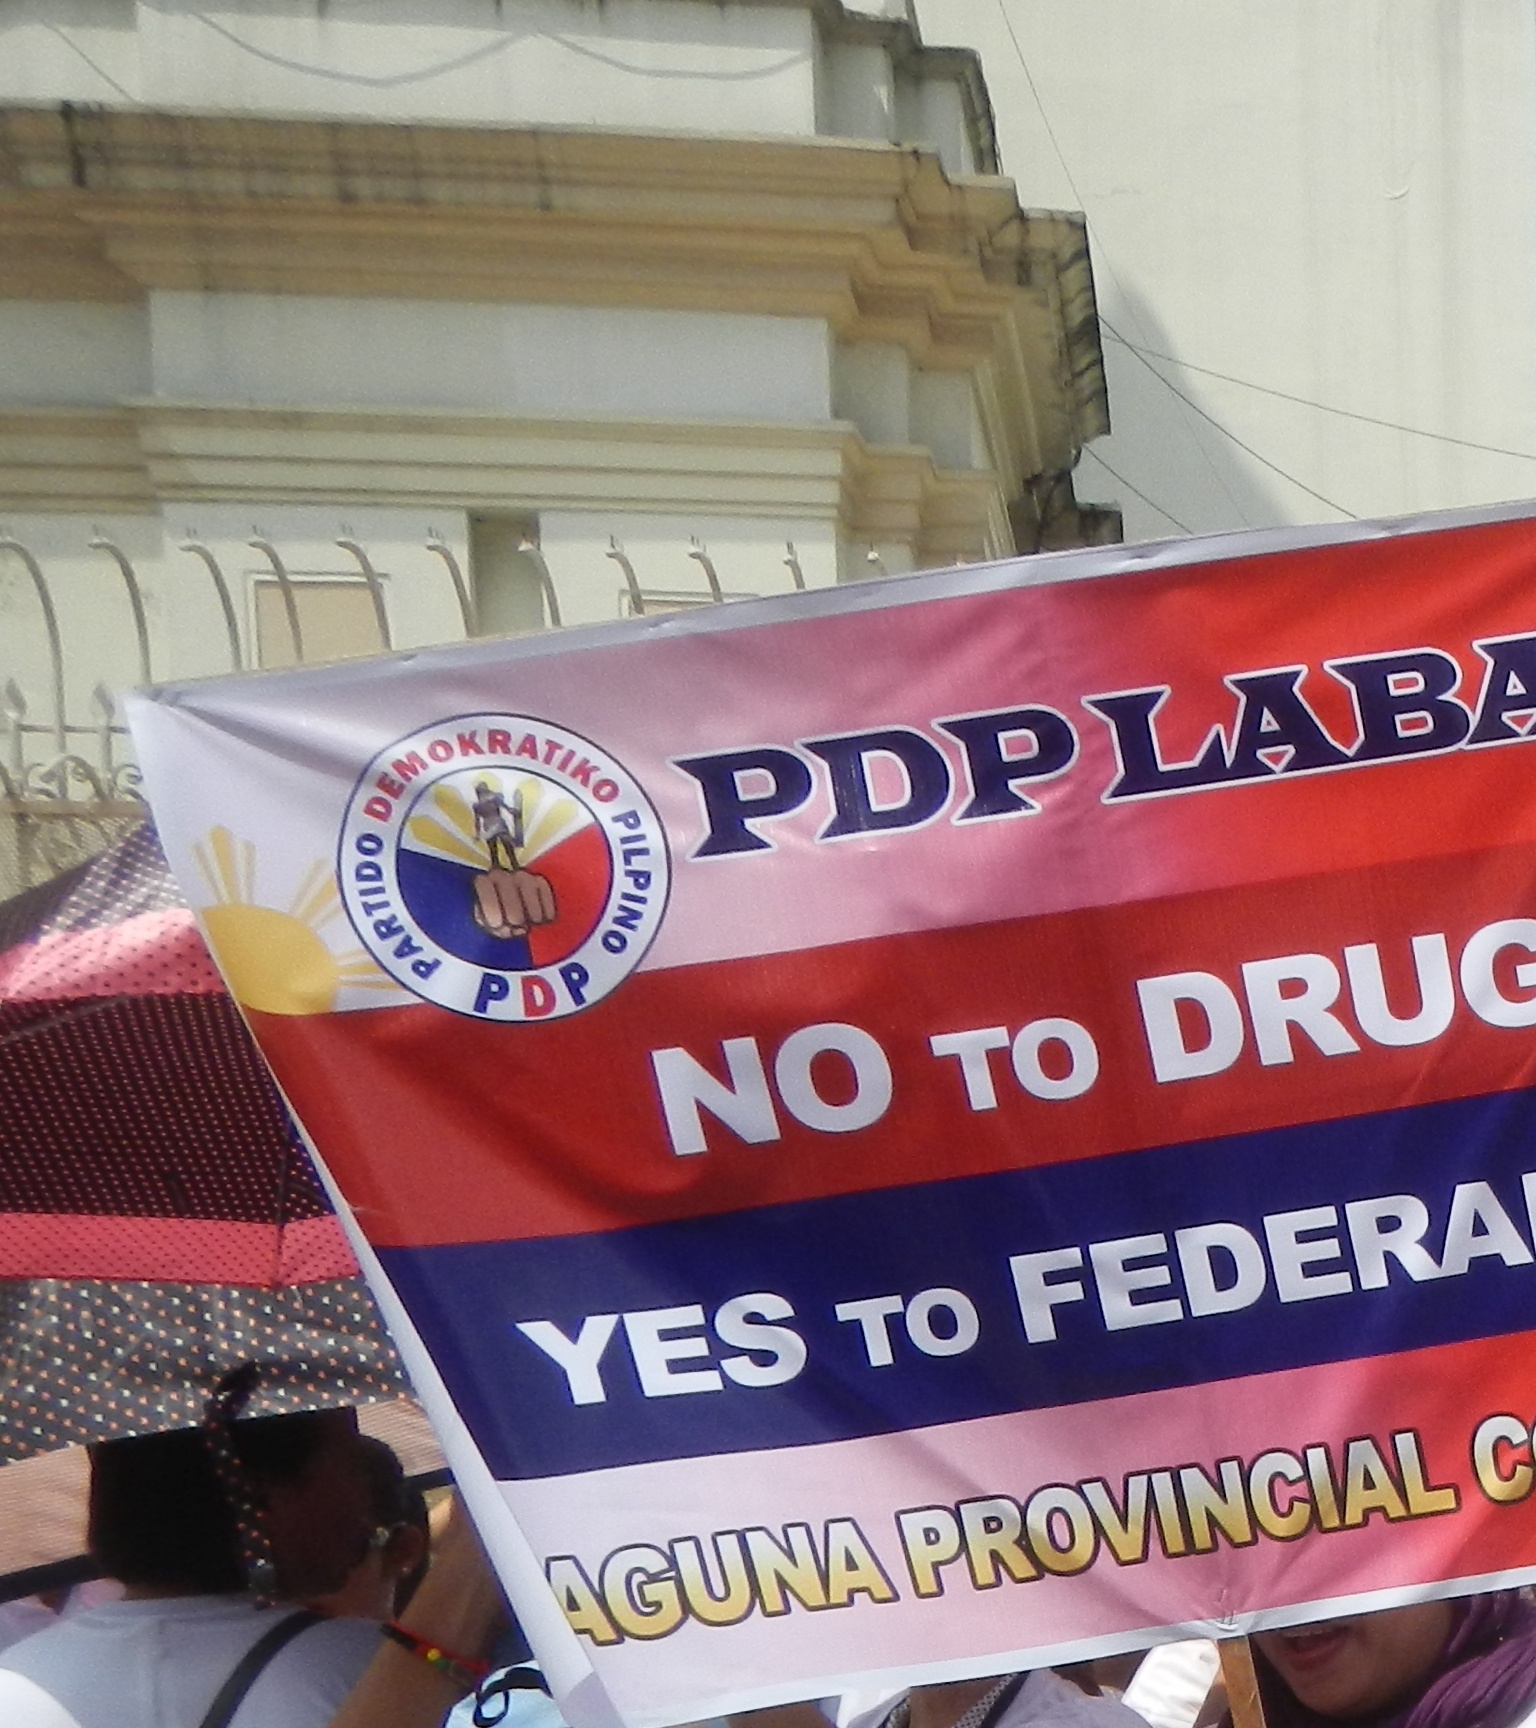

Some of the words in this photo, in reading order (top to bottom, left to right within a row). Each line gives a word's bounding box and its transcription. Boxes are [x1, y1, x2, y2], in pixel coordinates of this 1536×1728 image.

[363, 729, 620, 823] DEMOKRATIKO
[671, 703, 1077, 860] PDP
[355, 832, 442, 980] PARTIDO
[601, 810, 652, 955] PILPINO
[473, 962, 590, 1018] PDP
[651, 1022, 894, 1157] NO
[932, 1015, 1100, 1111] TO
[516, 1291, 809, 1406] YES
[834, 1286, 982, 1368] TO
[893, 1431, 1461, 1599] PROVINCIAL
